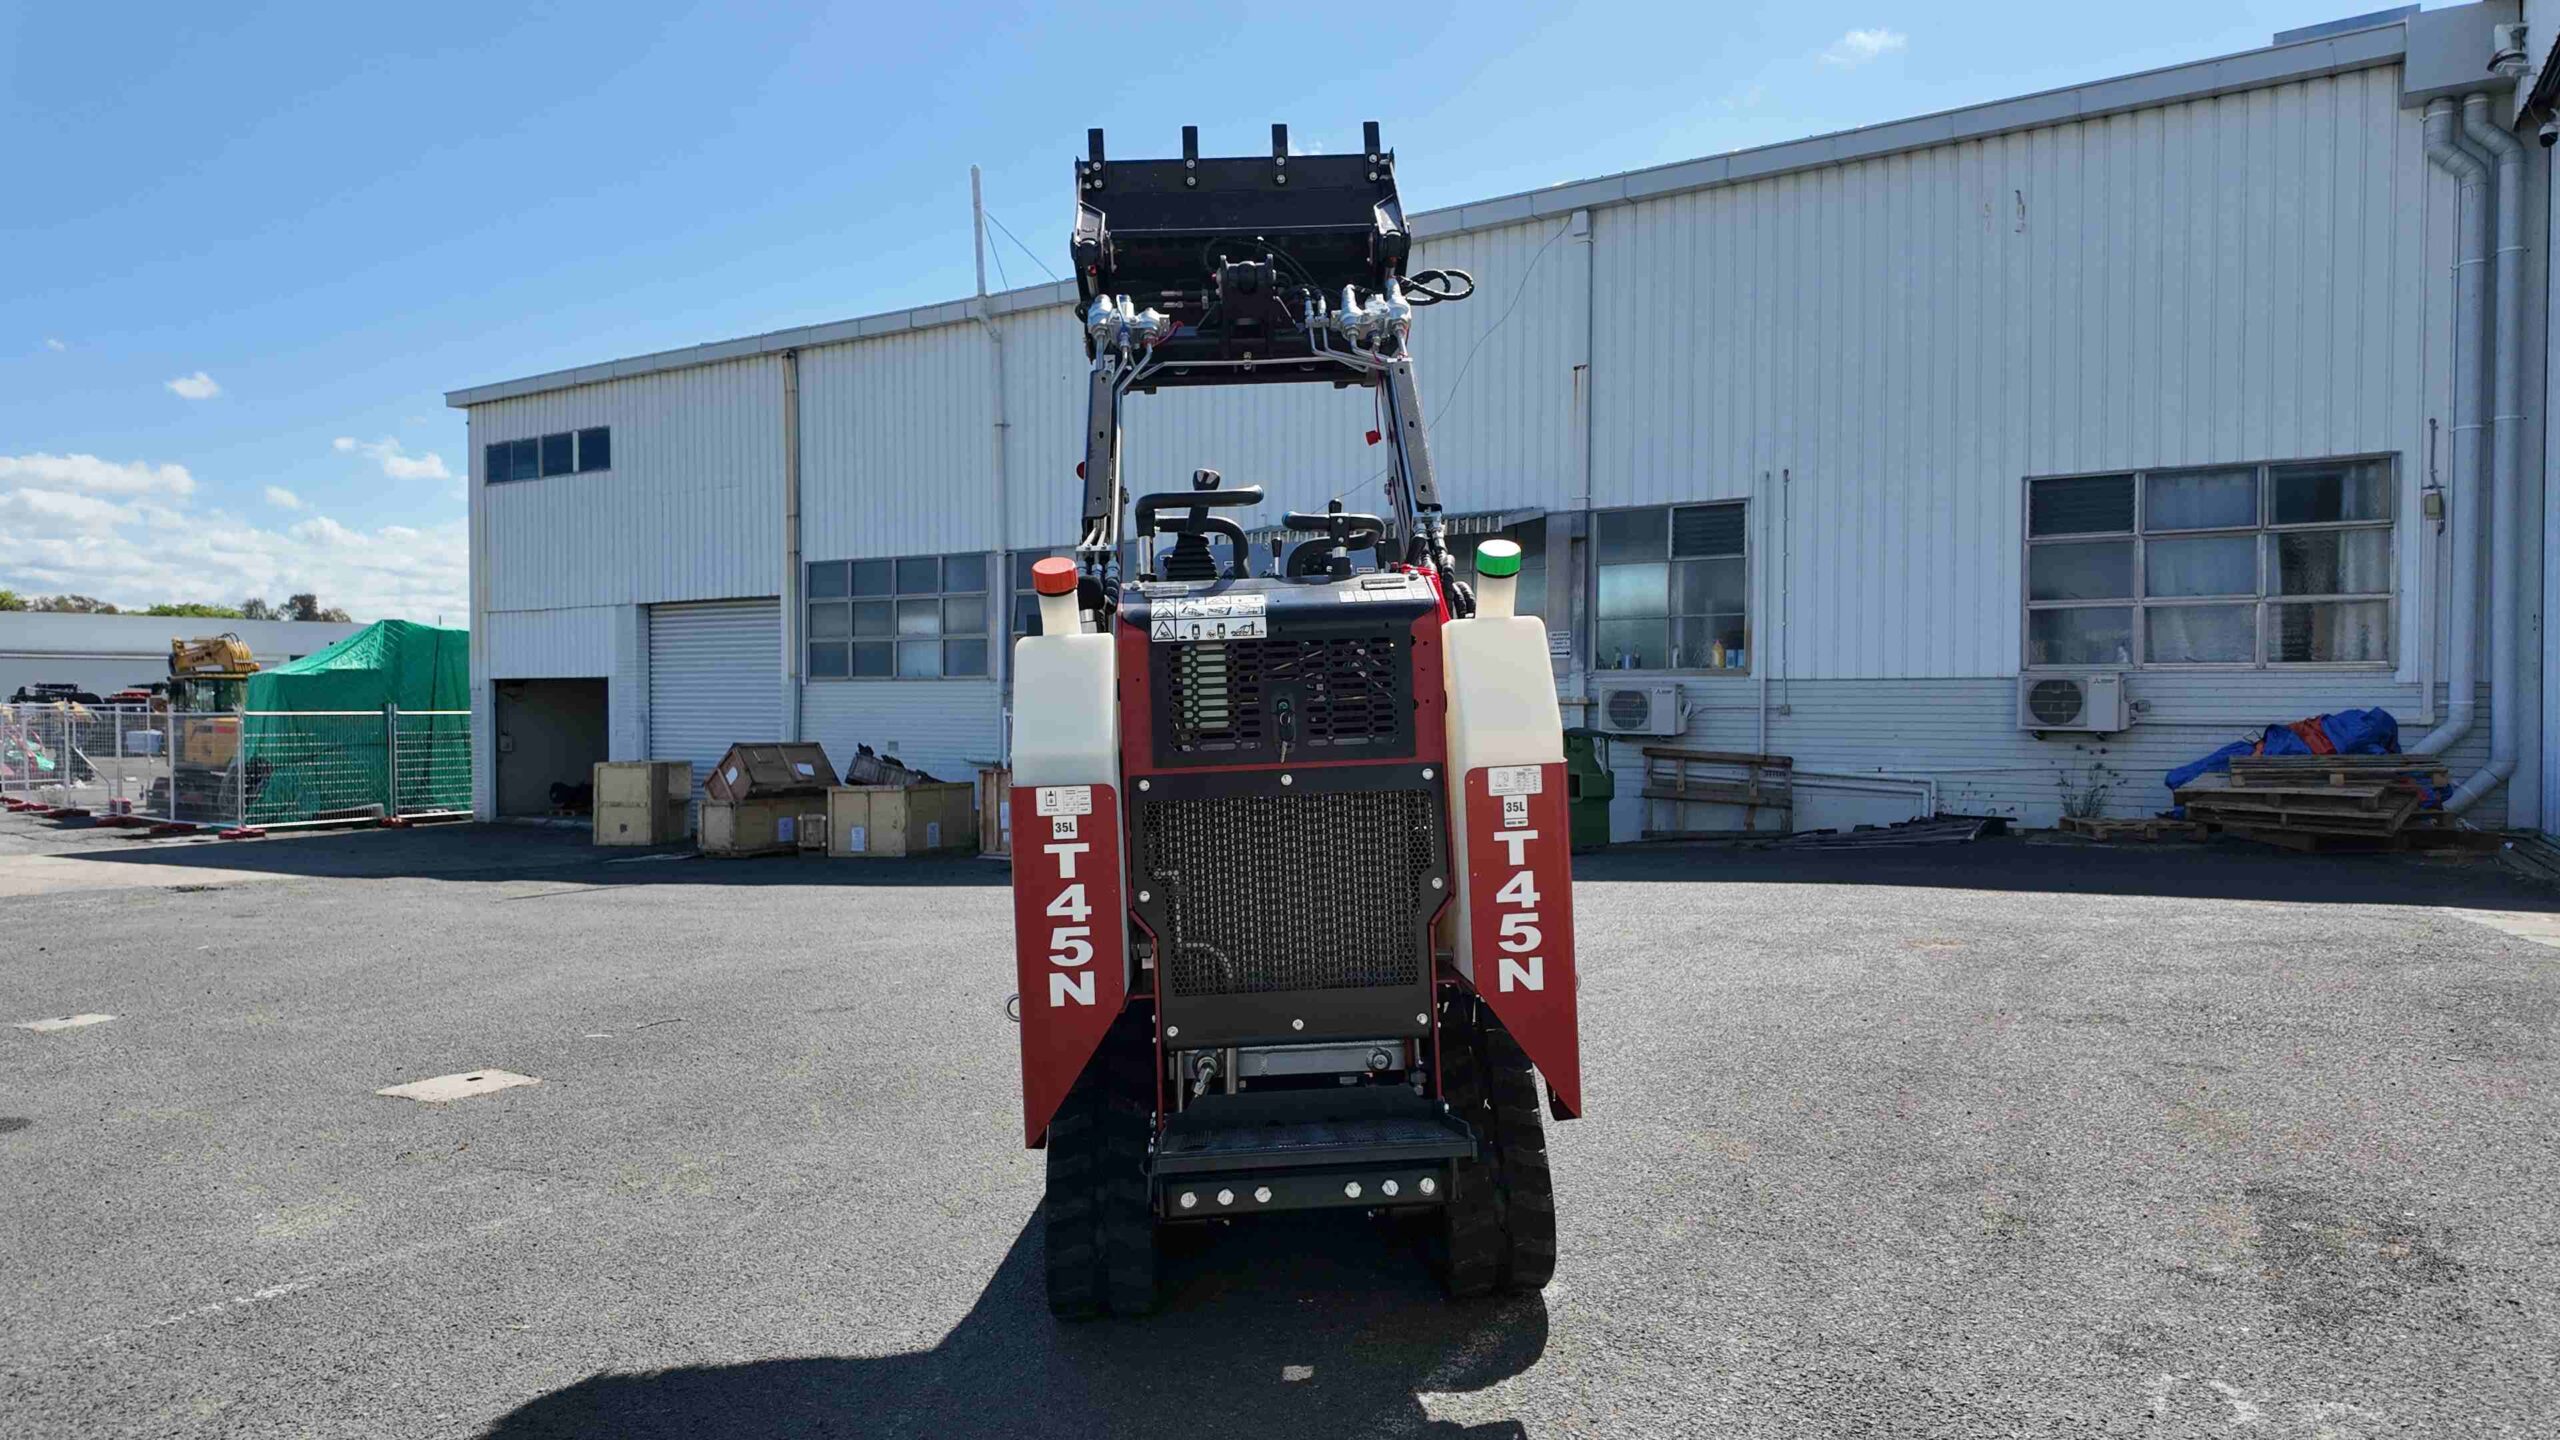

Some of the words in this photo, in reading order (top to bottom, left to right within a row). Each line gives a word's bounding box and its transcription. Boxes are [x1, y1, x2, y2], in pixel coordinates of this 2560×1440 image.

[1055, 822, 1075, 833] 35L
[1506, 801, 1525, 813] 35L
[1043, 842, 1096, 1008] T45N
[1494, 829, 1545, 993] T45N
